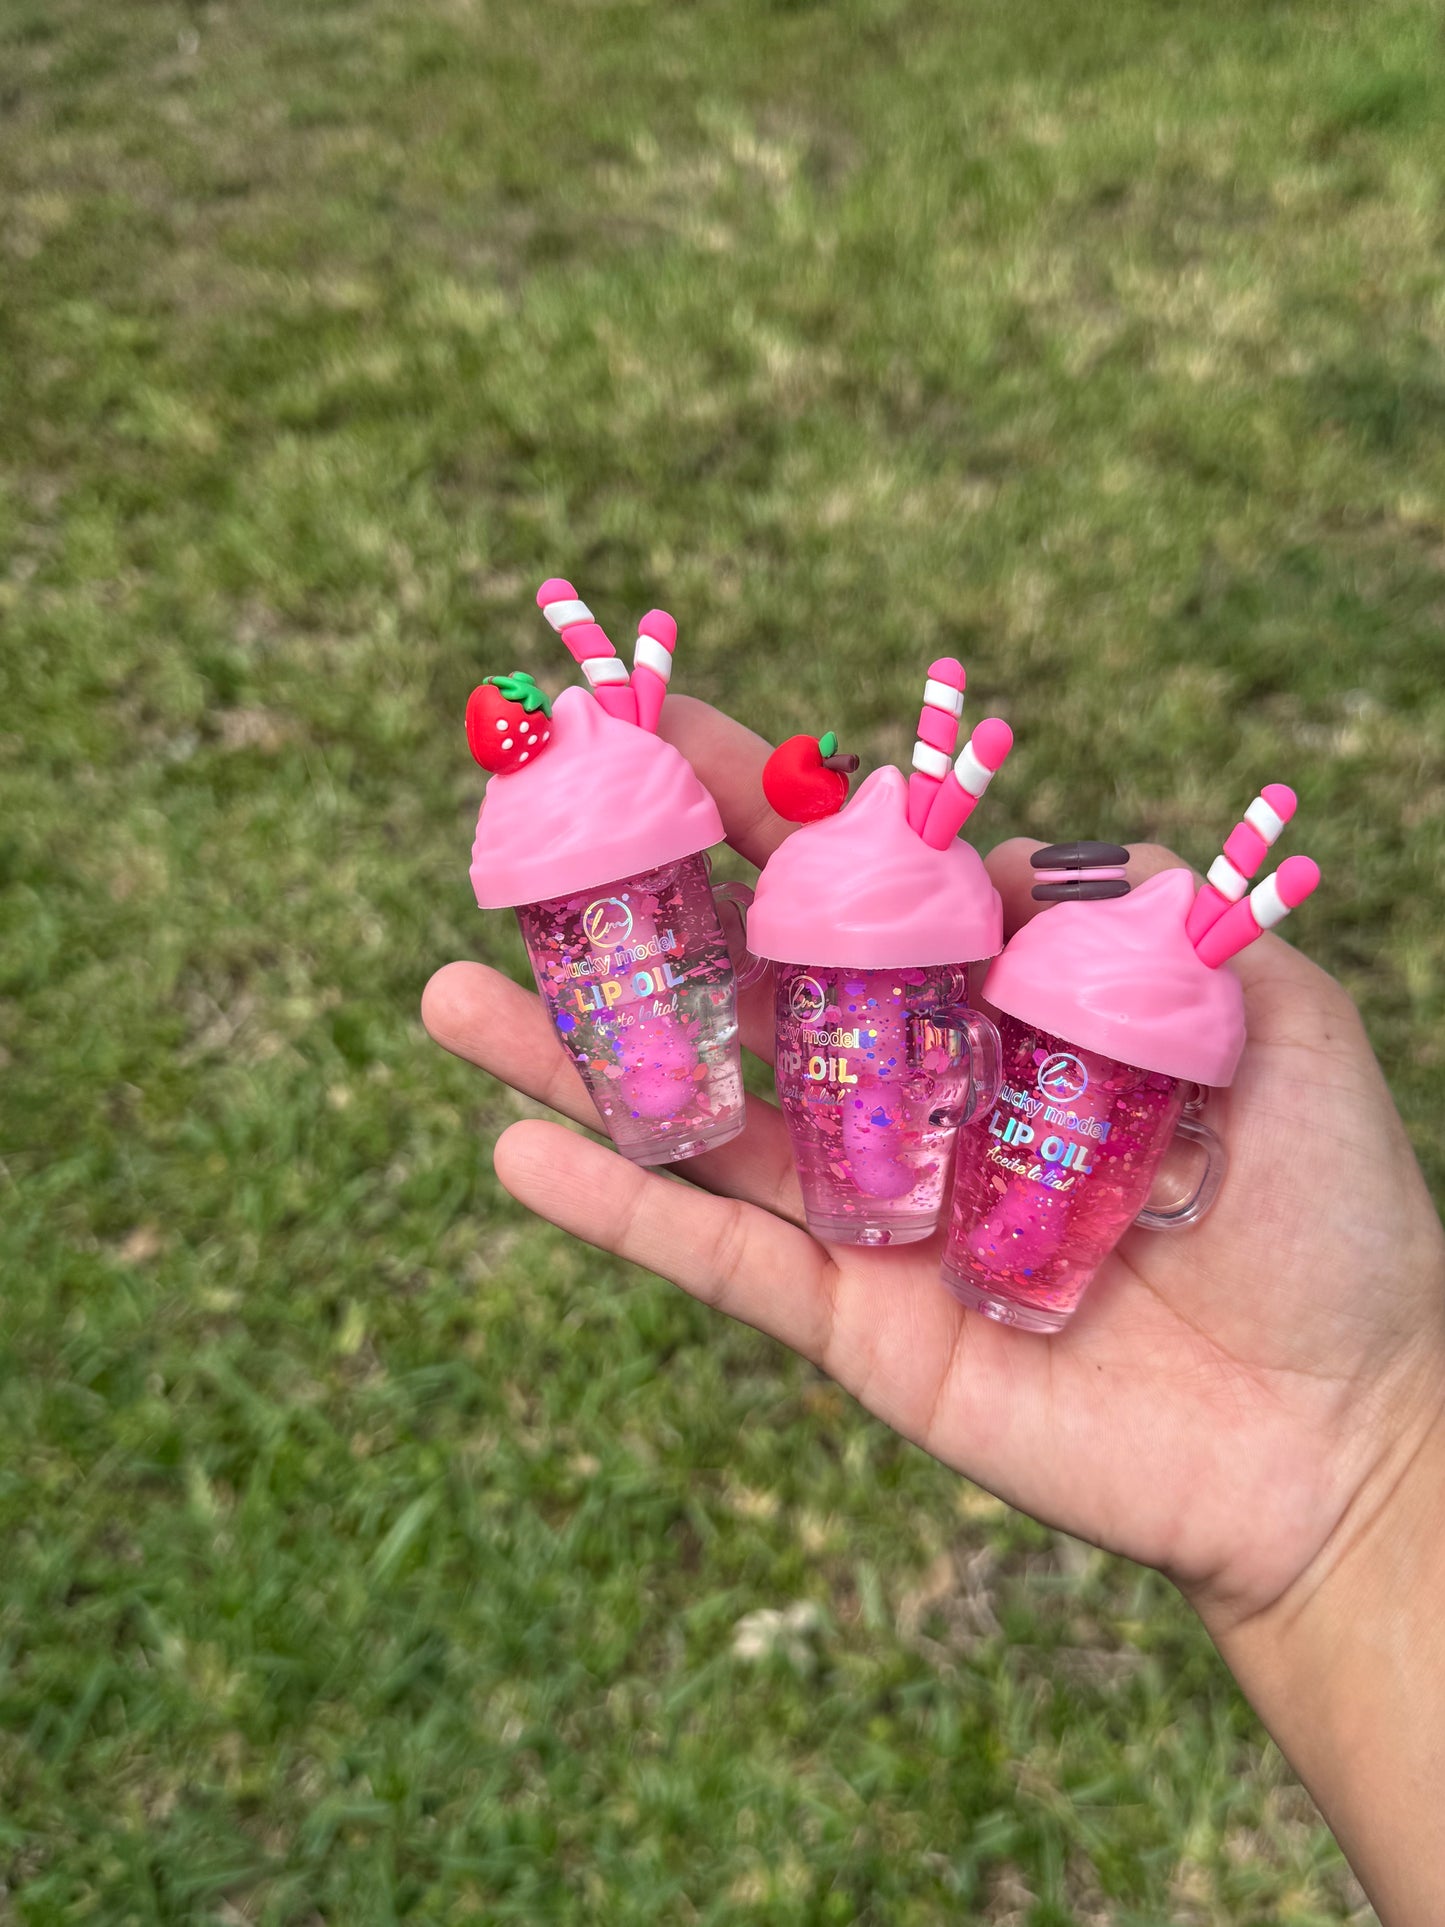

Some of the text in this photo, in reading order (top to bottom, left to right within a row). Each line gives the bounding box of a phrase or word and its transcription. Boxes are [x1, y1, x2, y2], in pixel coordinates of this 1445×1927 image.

[562, 929, 677, 981] lucky model
[573, 963, 685, 1013] LIP OIL
[803, 1027, 861, 1049] model
[808, 1055, 859, 1084] OIL
[988, 1110, 1093, 1175] LIP OIL
[1044, 1105, 1112, 1145] model
[986, 1145, 1027, 1175] Aceite
